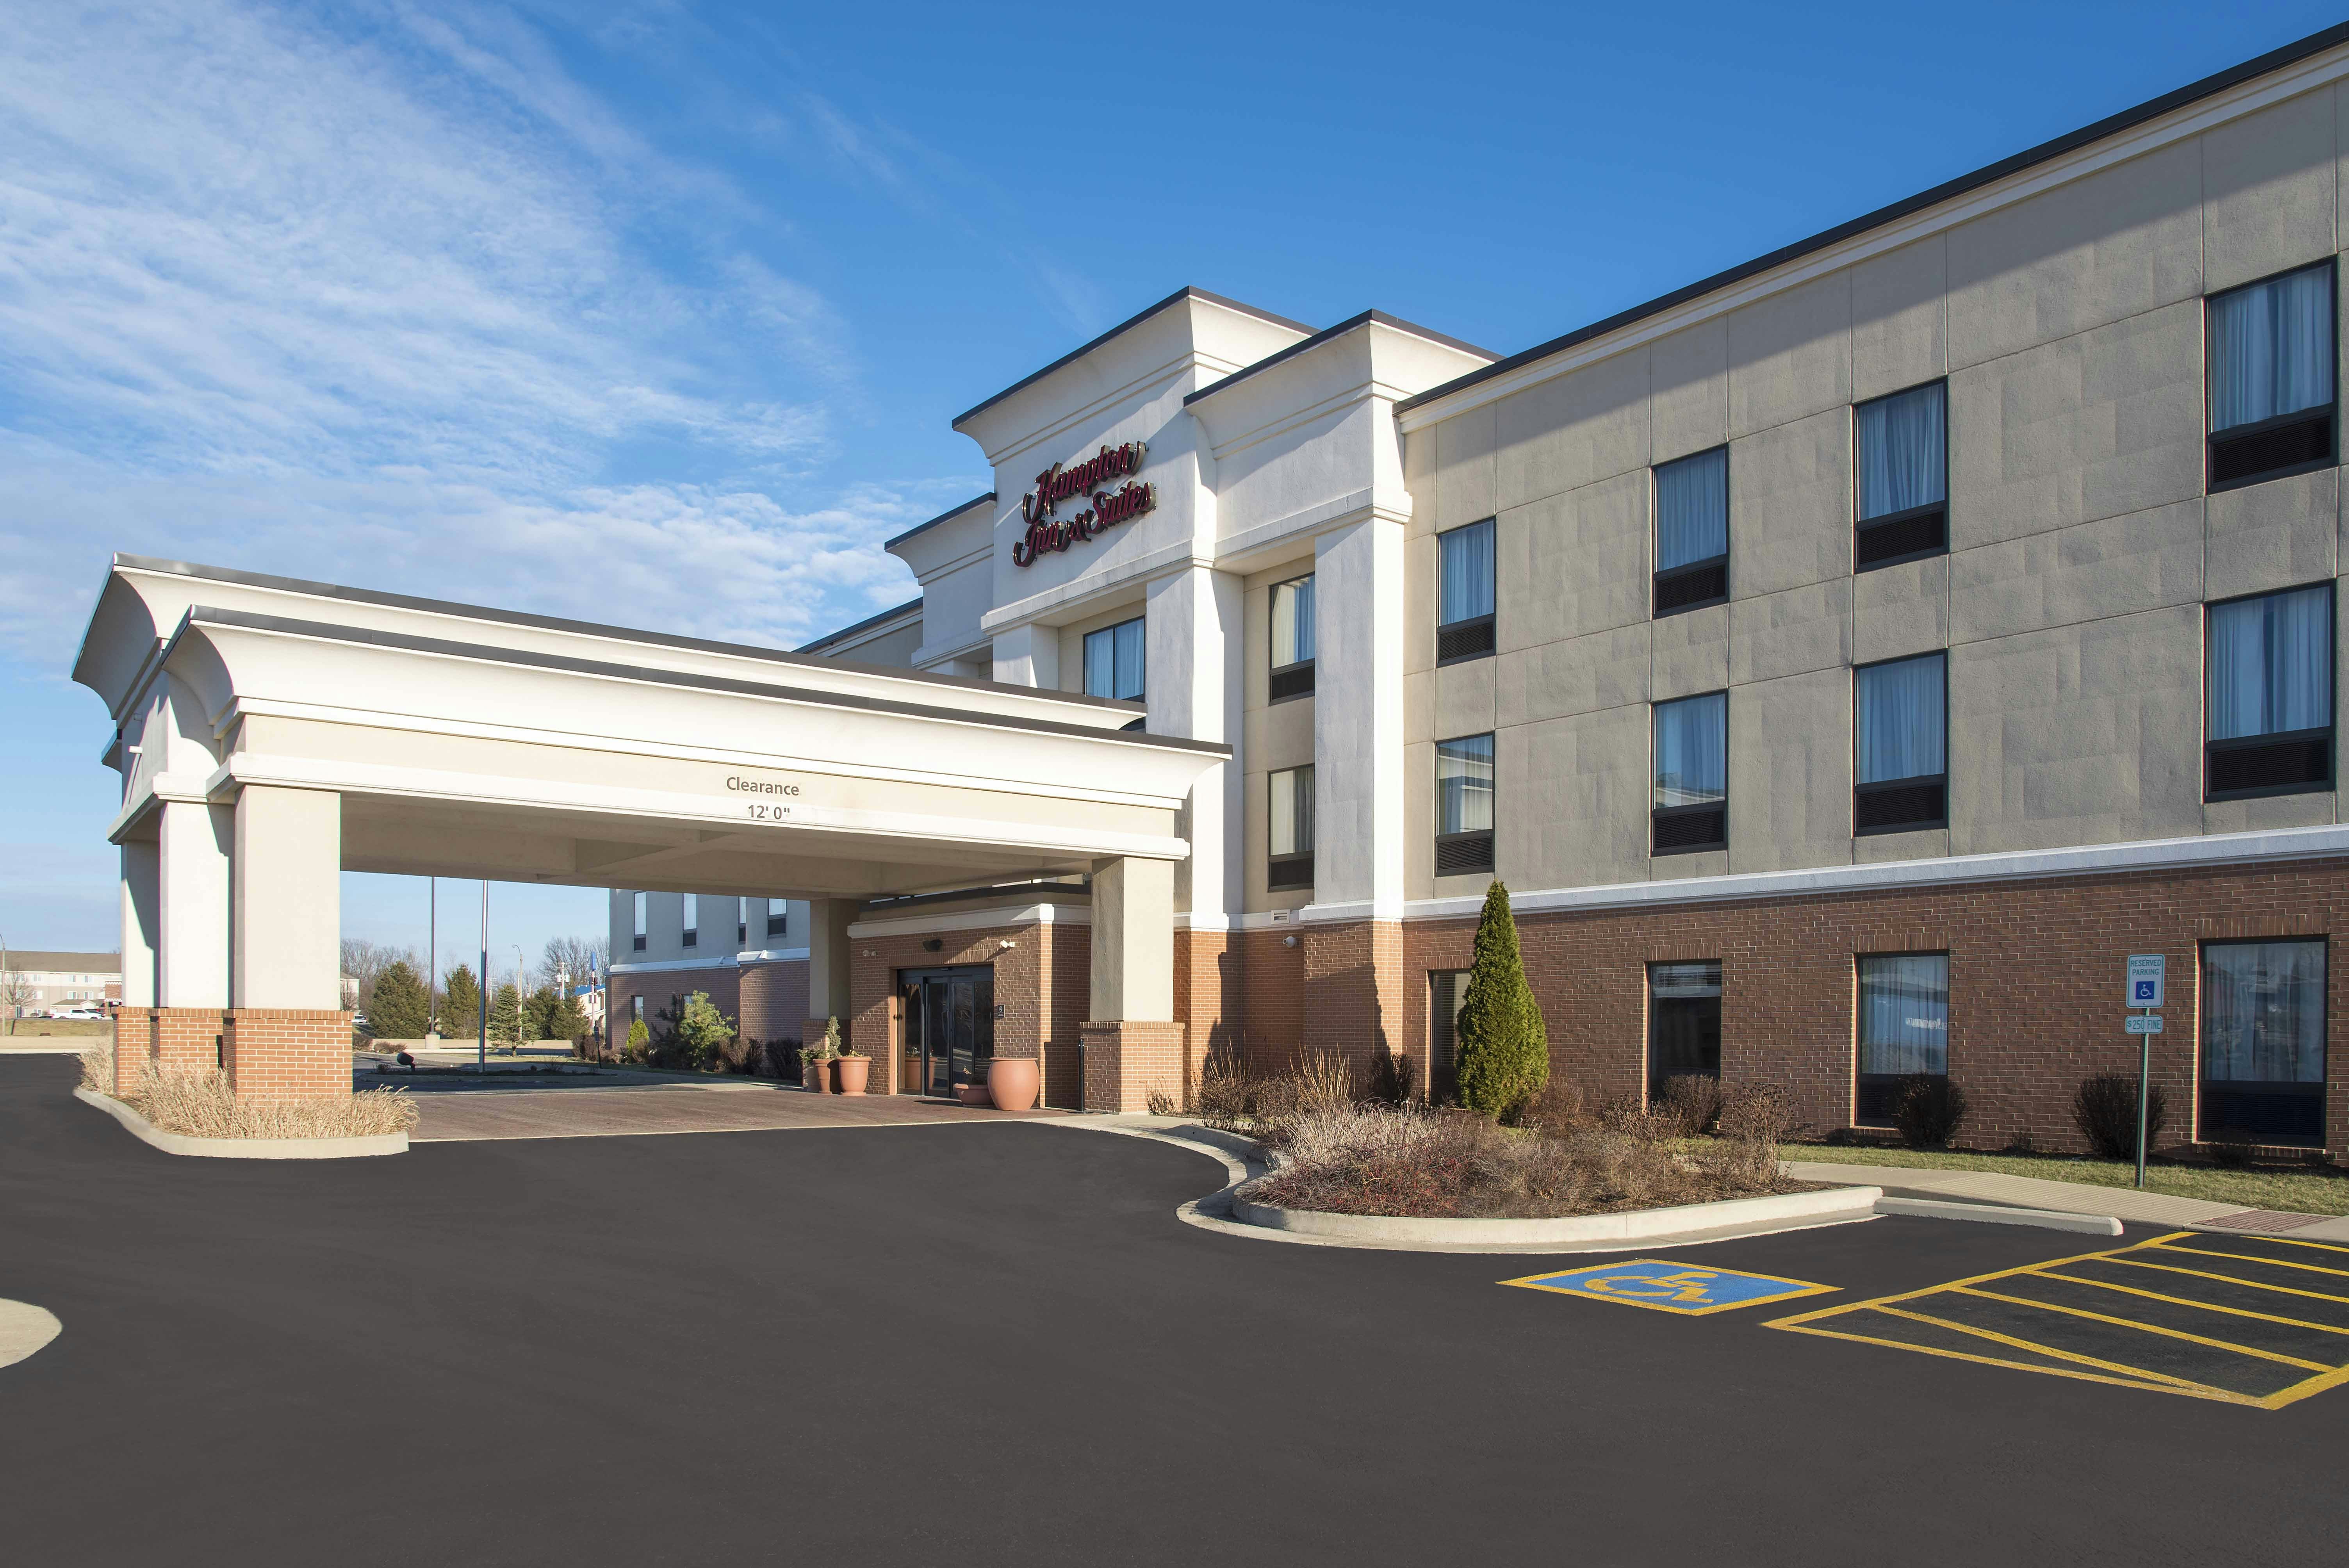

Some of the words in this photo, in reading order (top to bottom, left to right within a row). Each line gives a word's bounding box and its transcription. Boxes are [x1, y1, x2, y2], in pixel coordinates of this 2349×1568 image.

[1022, 441, 1146, 524] Hampton
[1013, 520, 1074, 568] Inn
[1069, 513, 1091, 542] &
[1083, 481, 1156, 535] Suites
[726, 777, 799, 796] Clearance
[748, 805, 768, 818] 12'
[773, 807, 790, 820] 0"
[2127, 1020, 2145, 1030] $250
[2148, 1019, 2161, 1030] FINE
